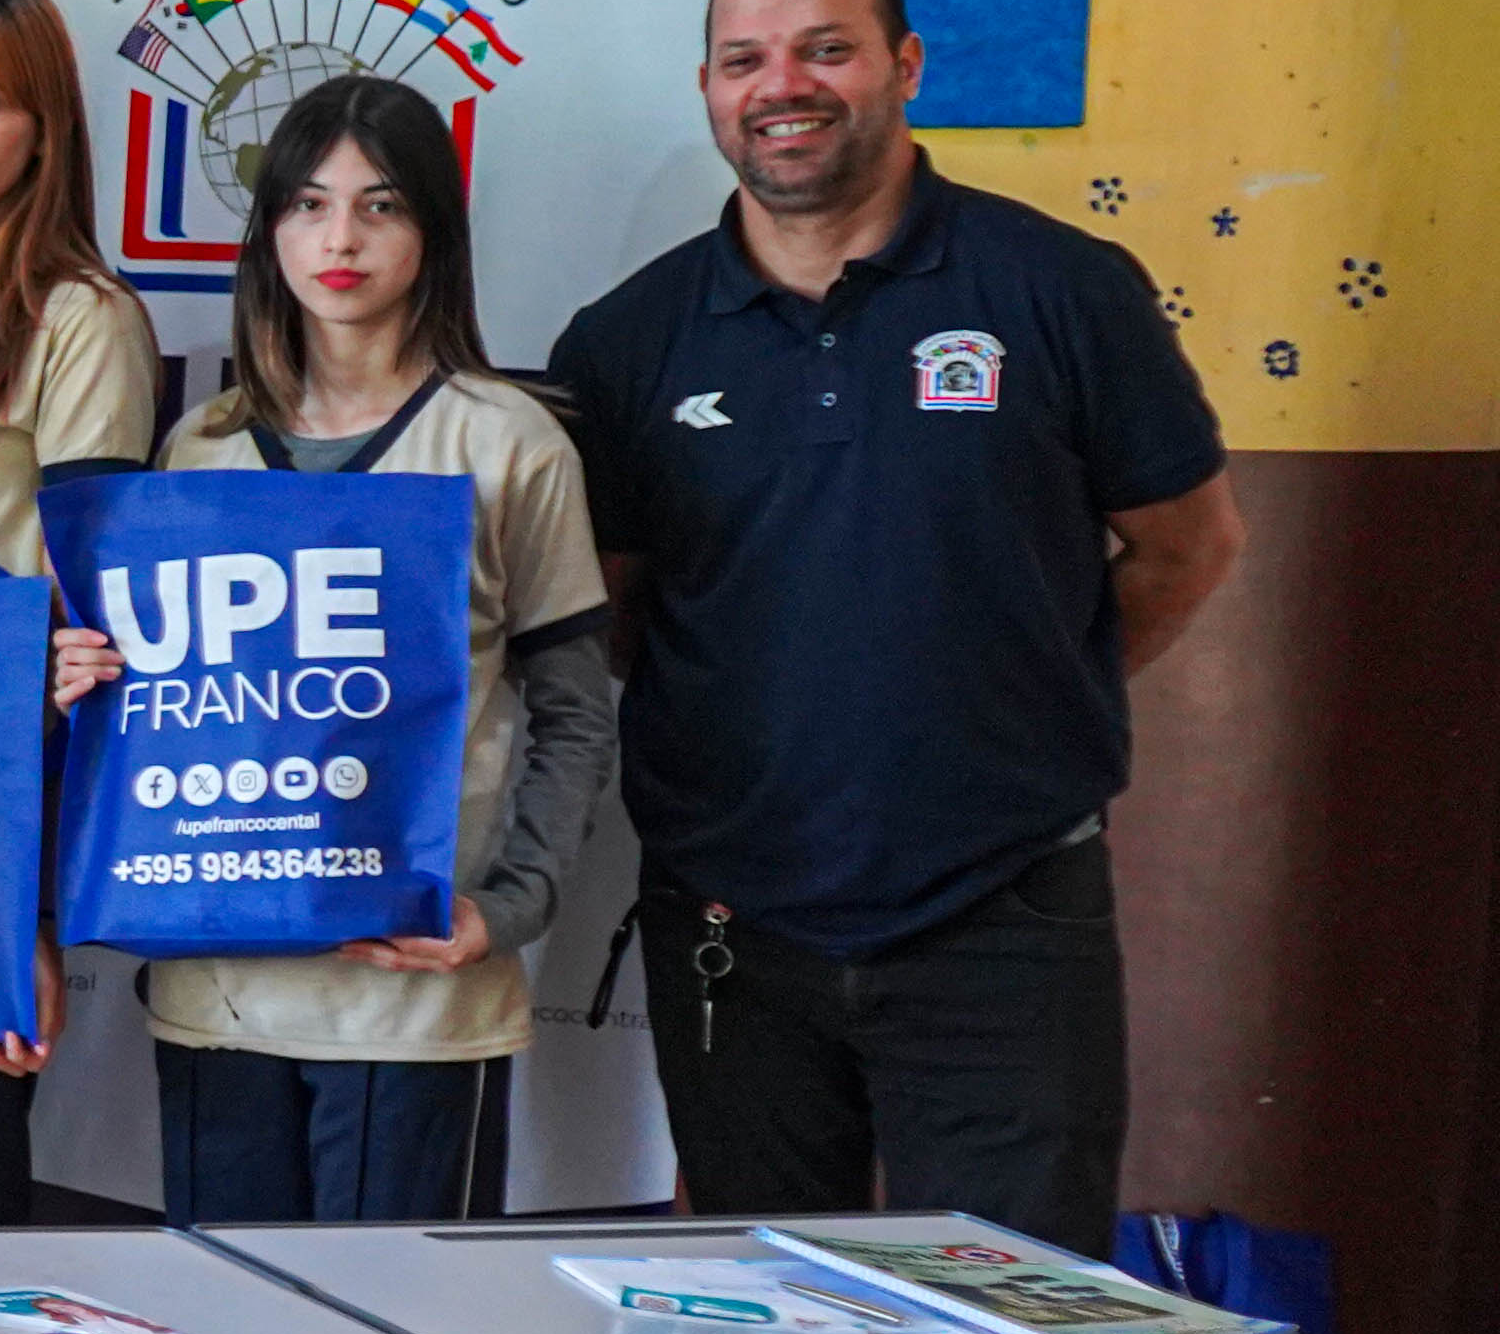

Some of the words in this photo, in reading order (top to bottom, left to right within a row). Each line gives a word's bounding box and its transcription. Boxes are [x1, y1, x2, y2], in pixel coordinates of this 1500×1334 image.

[101, 547, 386, 674] UPE
[120, 665, 391, 735] FRANCO
[113, 853, 193, 886] +595
[199, 846, 384, 883] 984364238
